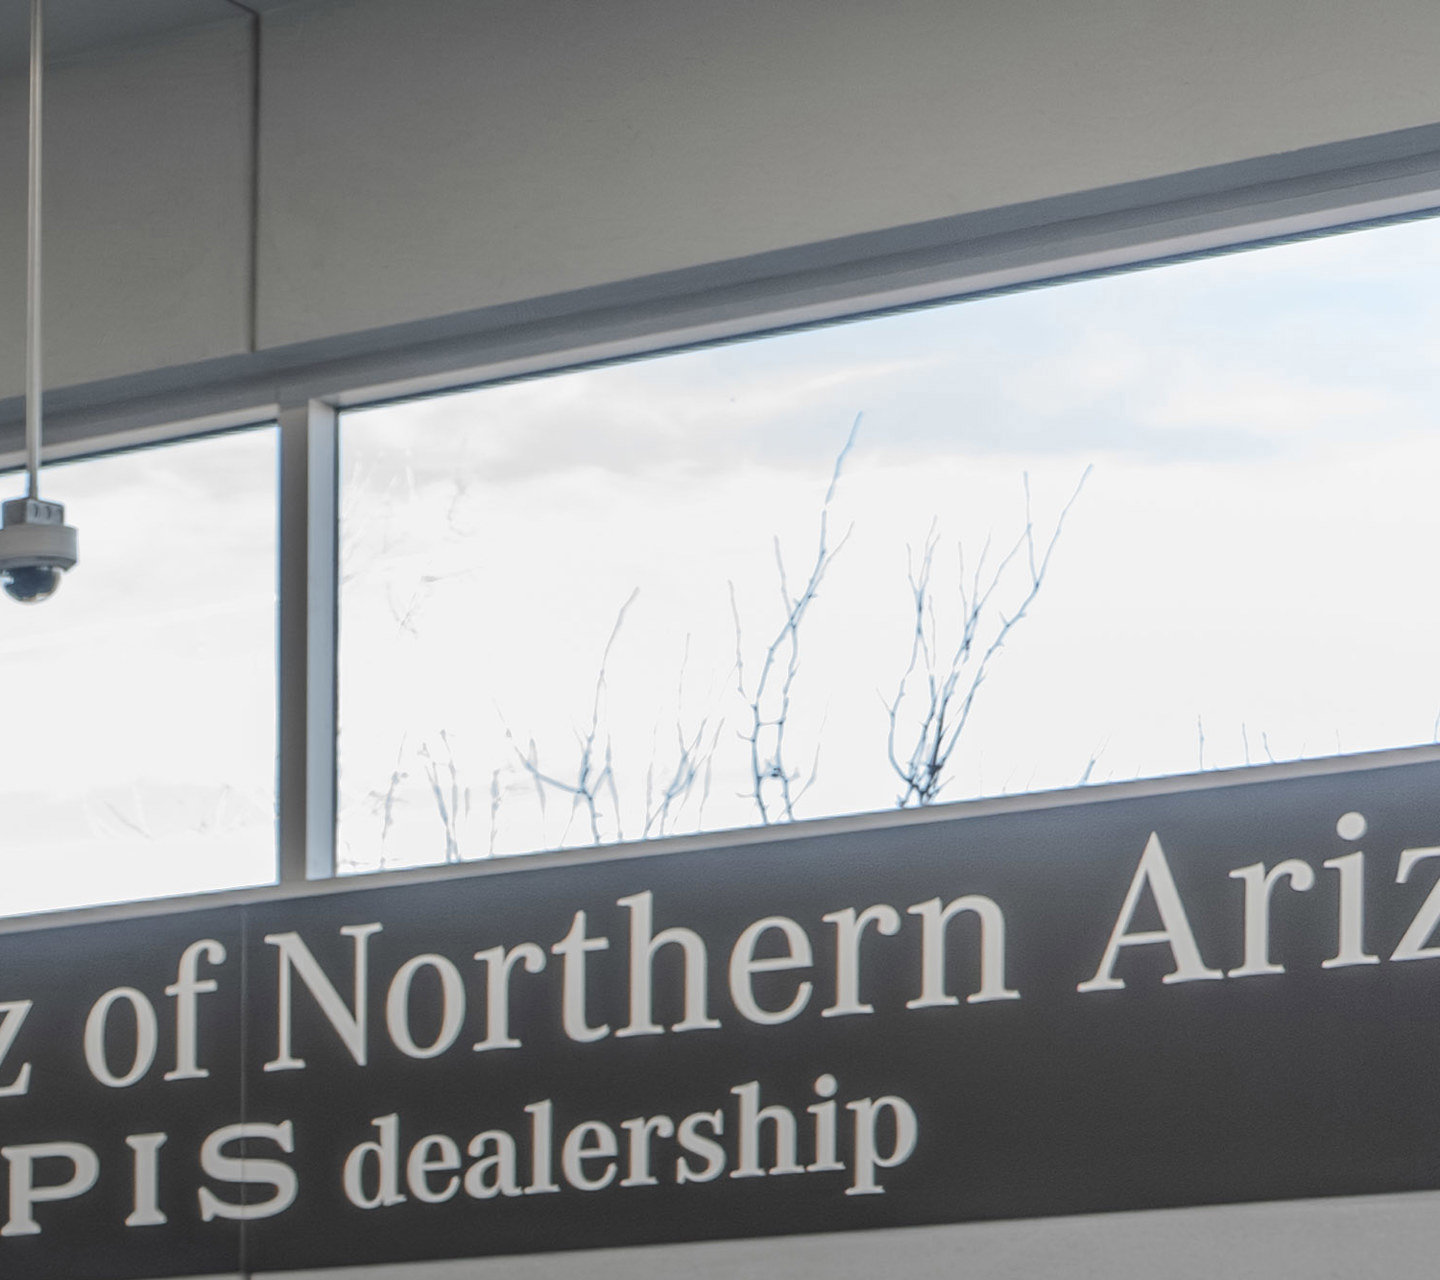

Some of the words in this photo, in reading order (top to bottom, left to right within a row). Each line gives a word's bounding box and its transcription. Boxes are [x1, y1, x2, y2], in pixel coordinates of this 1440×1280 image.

[83, 938, 228, 1088] of
[263, 889, 1021, 1072] Northern
[342, 1072, 919, 1209] dealership
